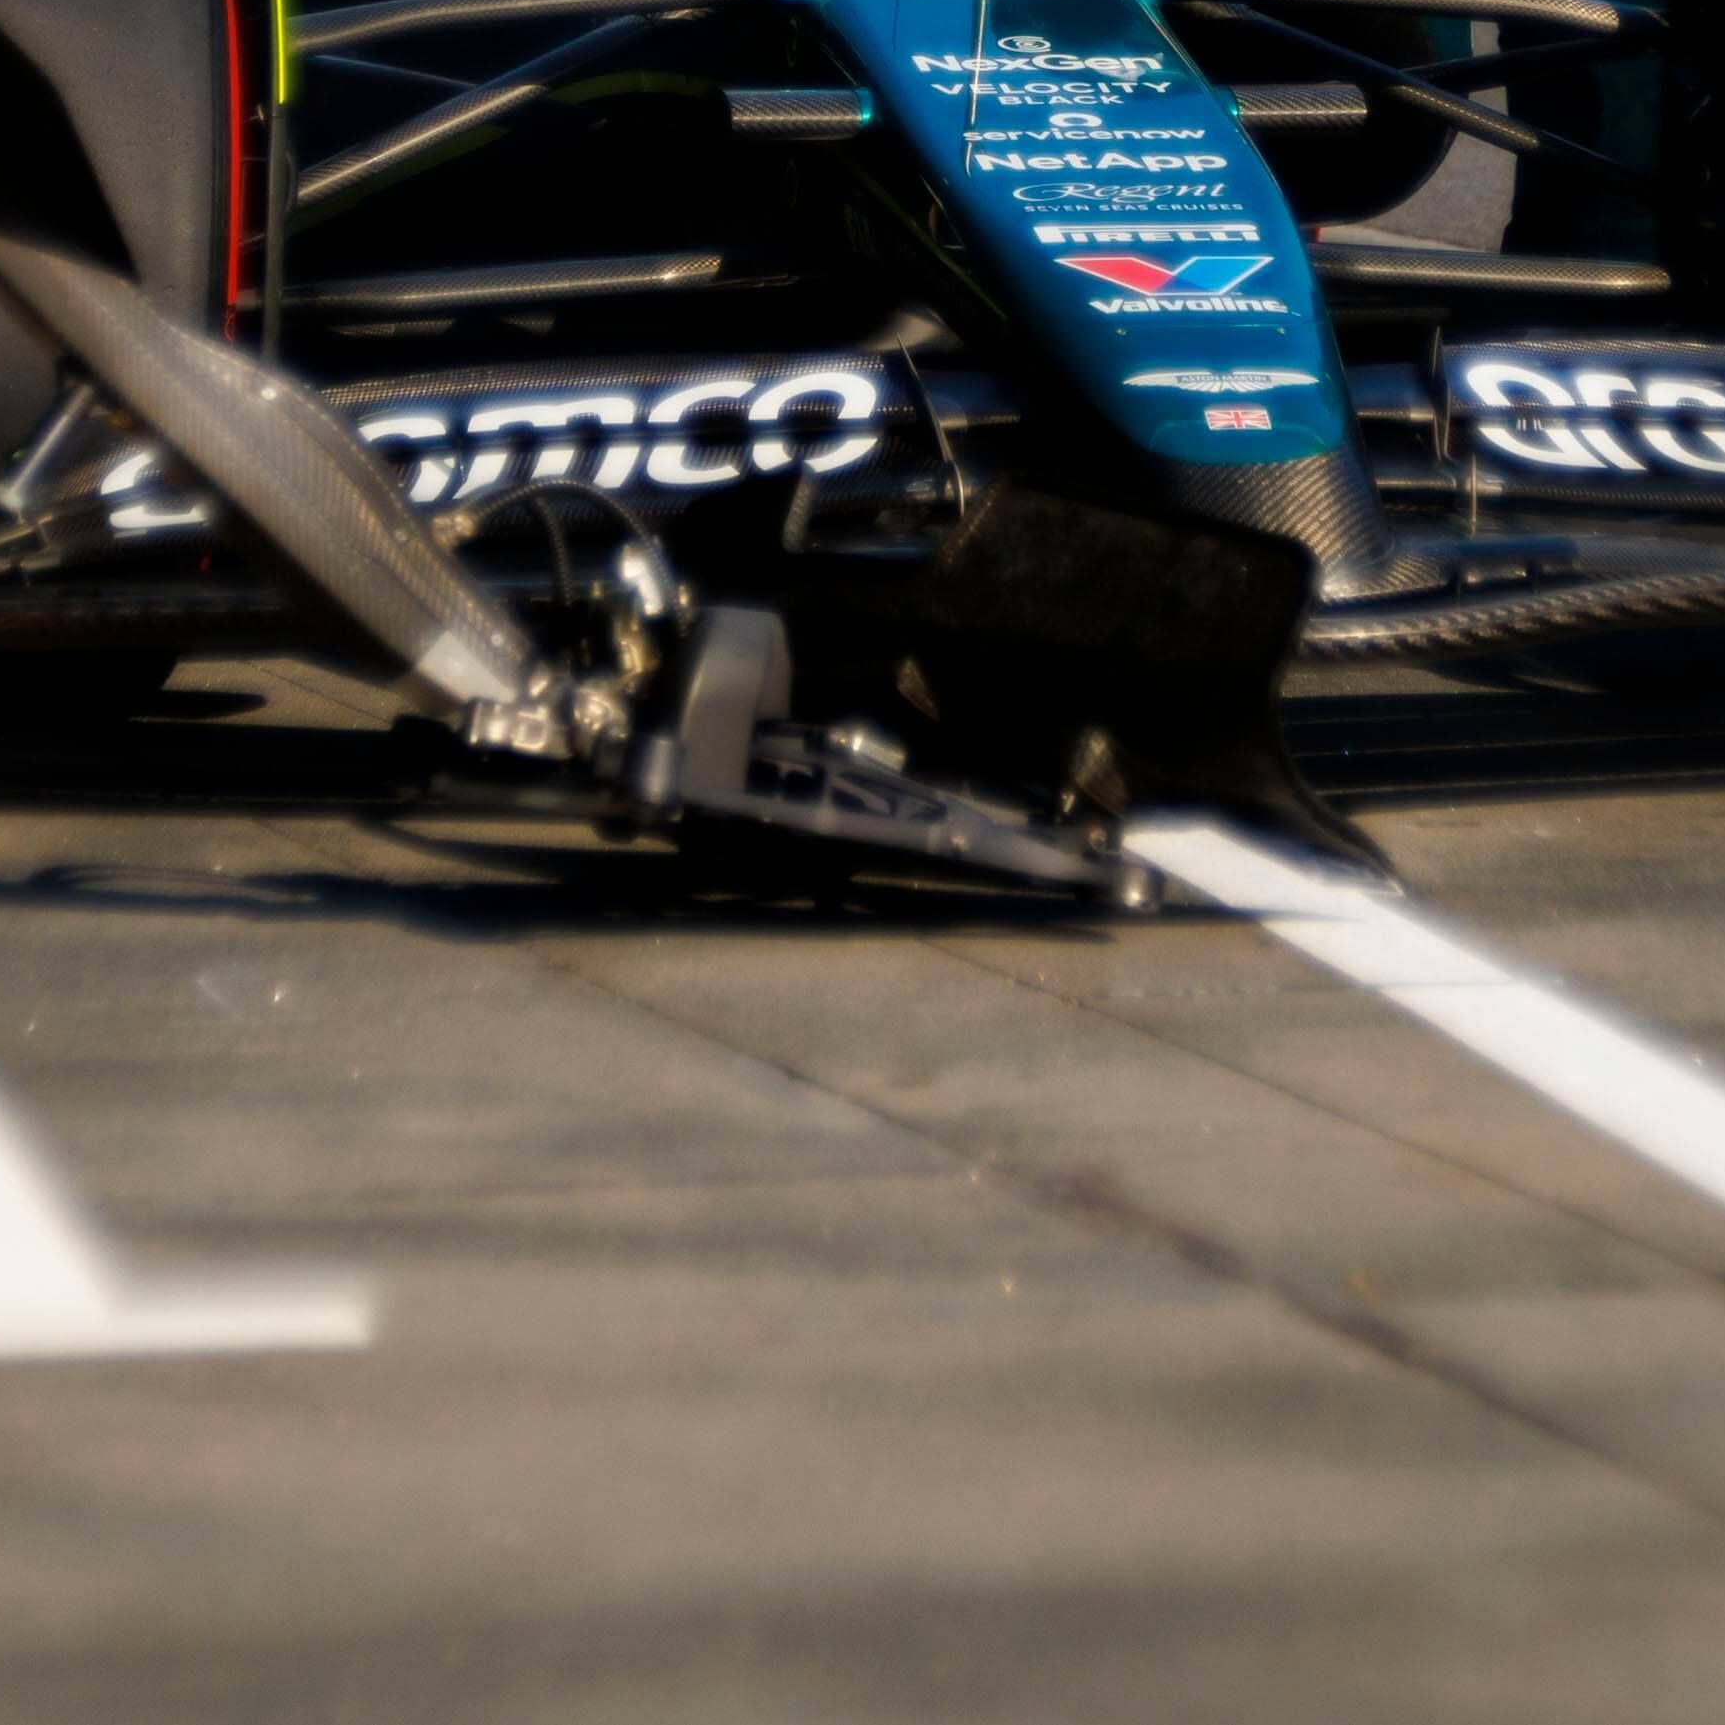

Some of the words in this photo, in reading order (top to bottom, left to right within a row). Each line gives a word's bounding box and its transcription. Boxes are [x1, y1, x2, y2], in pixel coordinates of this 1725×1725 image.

[911, 53, 1164, 72] NexGen
[931, 81, 1173, 95] VELOCITY
[998, 95, 1125, 106] BLACK
[963, 127, 1206, 141] servicenow
[974, 152, 1228, 173] NetApp
[1012, 182, 1229, 204] Regent
[1024, 204, 1091, 213] SEVEN
[1099, 204, 1150, 213] SEAS
[1155, 203, 1244, 212] CRUISES
[1033, 224, 1261, 244] PIRELLI
[1089, 296, 1289, 315] Valvoline
[1180, 375, 1222, 383] ASTON
[1225, 375, 1268, 383] MARTIN
